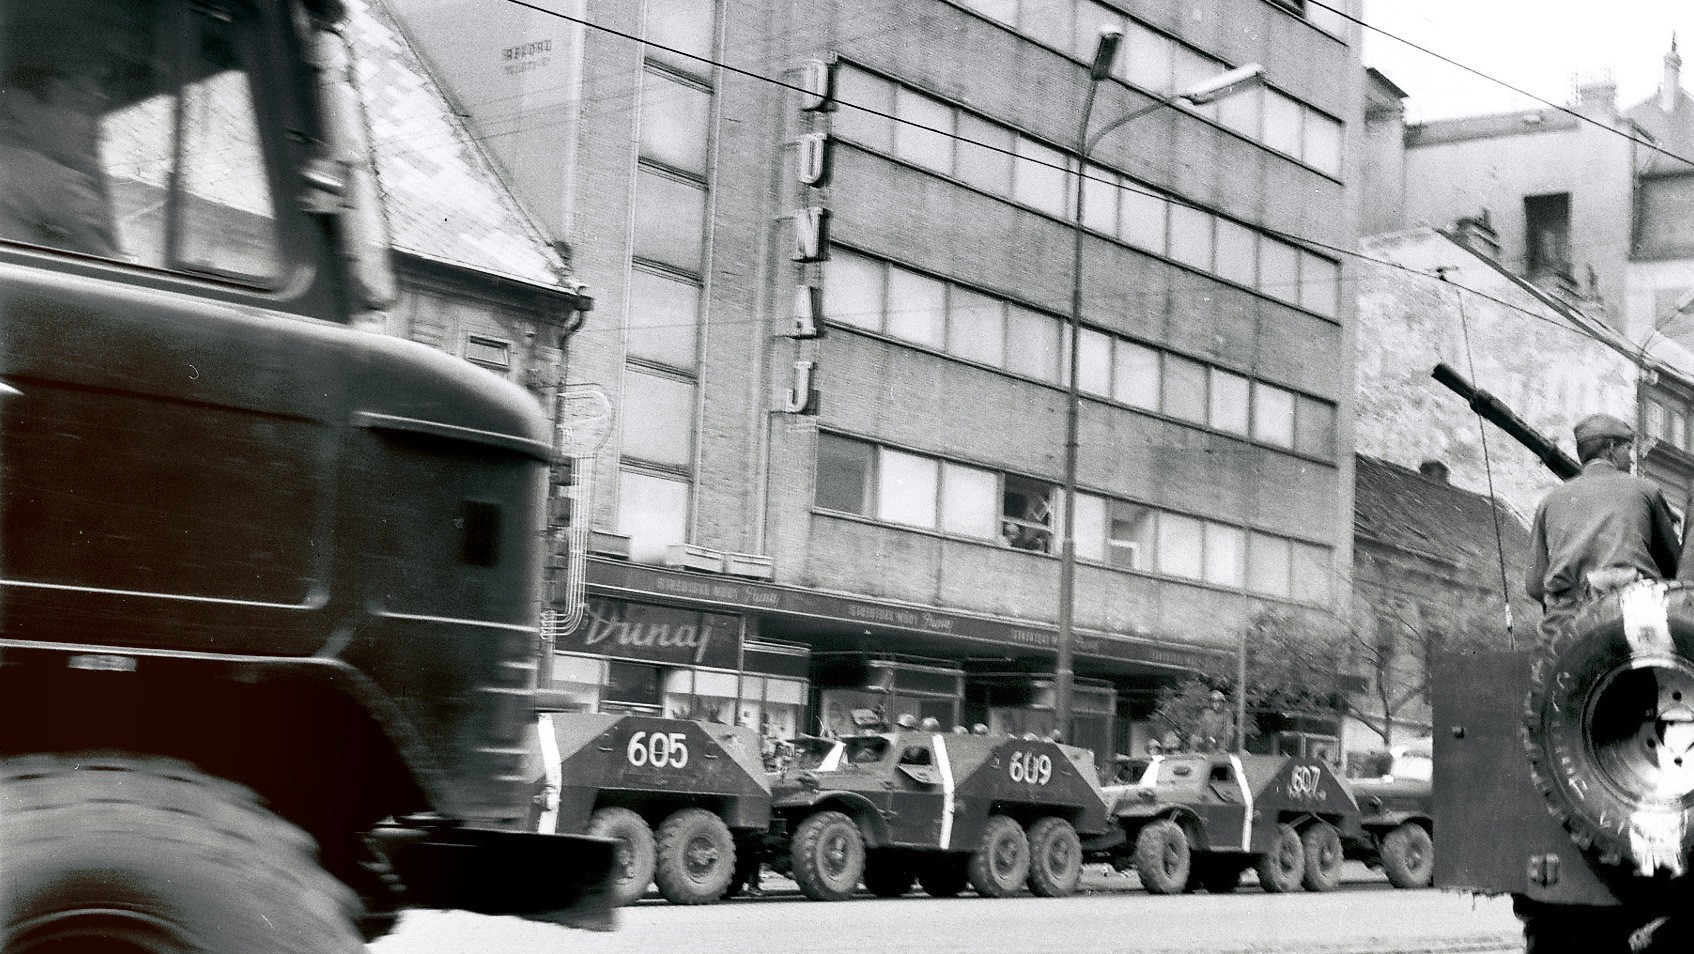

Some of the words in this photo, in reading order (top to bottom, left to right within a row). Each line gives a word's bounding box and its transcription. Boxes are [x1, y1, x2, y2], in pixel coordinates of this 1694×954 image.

[786, 58, 830, 413] DUNAJ
[583, 603, 713, 663] Dunaj
[627, 731, 688, 769] 605
[1009, 751, 1052, 785] 609
[1292, 765, 1320, 794] 607
